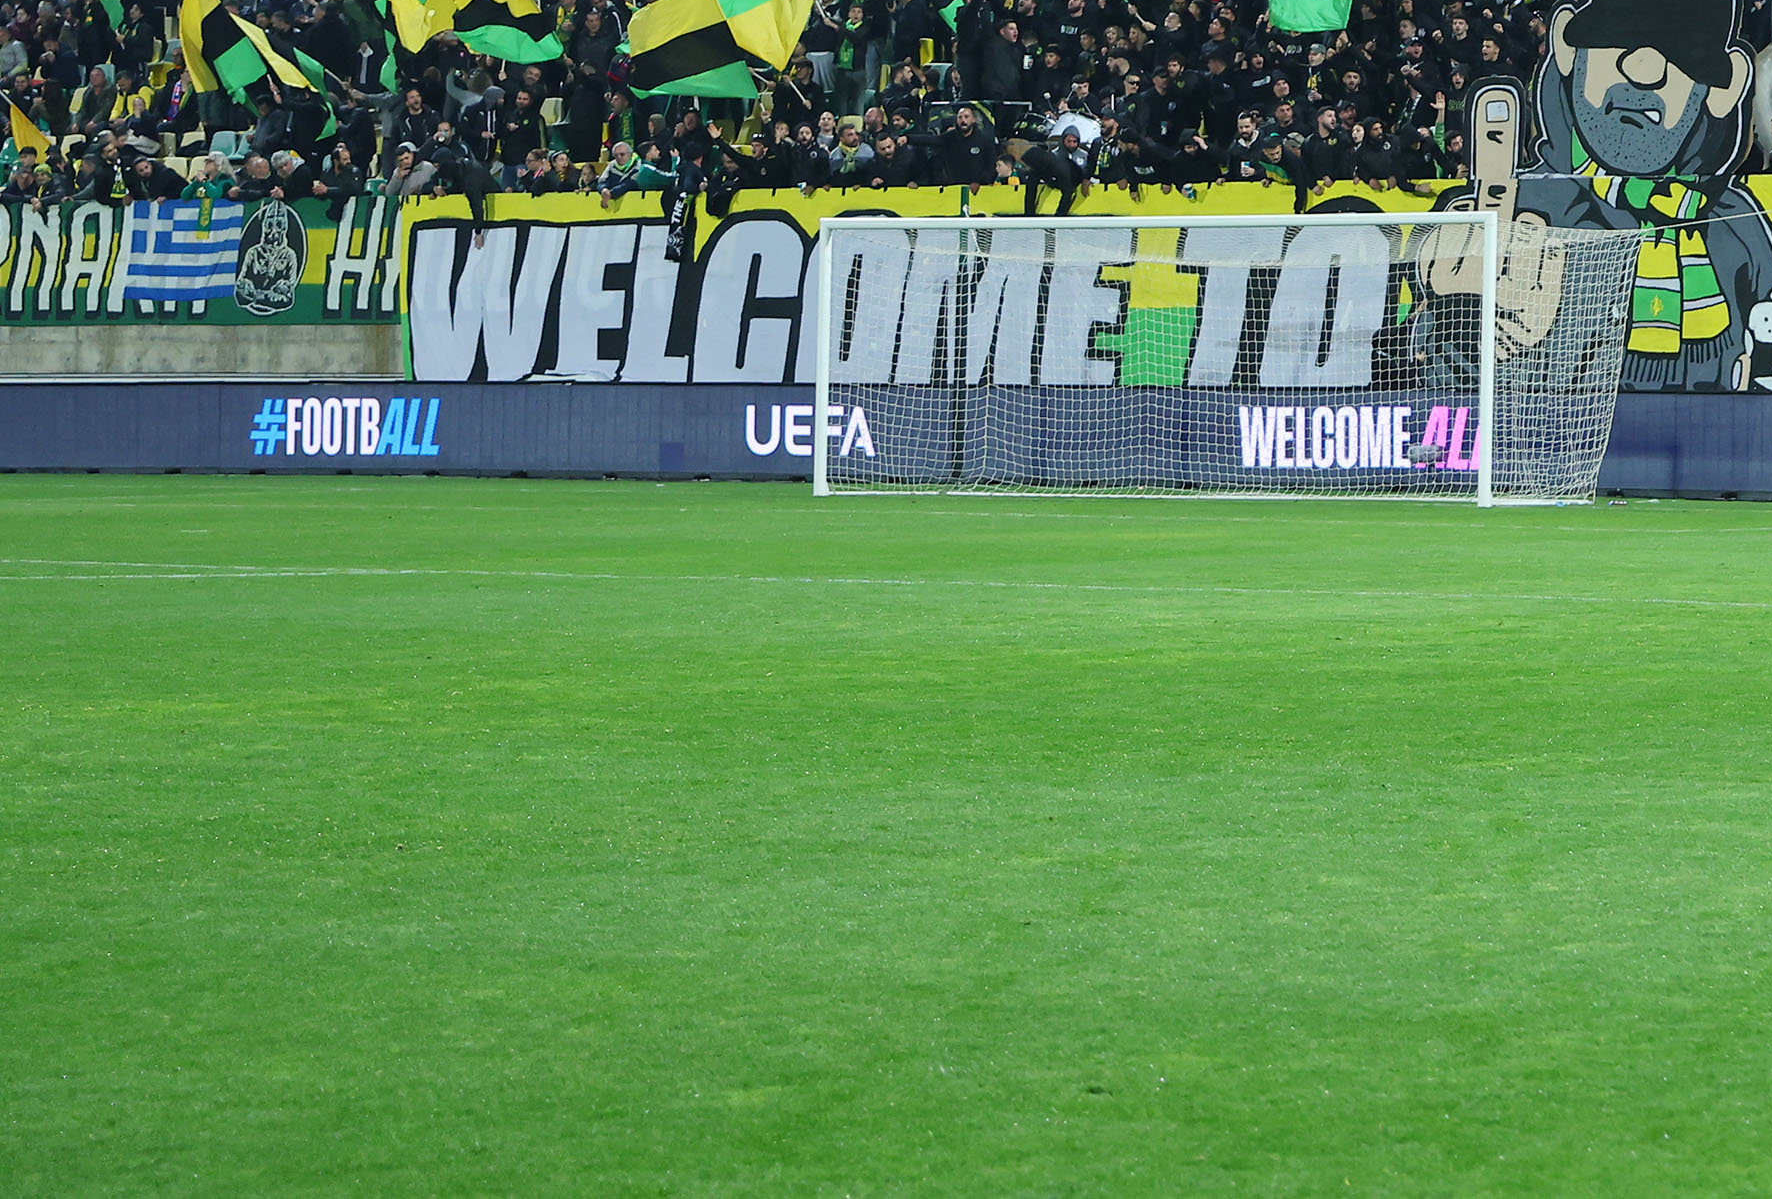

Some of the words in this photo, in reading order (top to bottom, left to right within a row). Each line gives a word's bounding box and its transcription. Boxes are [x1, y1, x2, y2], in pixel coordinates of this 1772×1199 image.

[411, 216, 1136, 387] WELCOME
[1182, 208, 1393, 388] TO
[249, 397, 441, 457] #FOOTBALL
[1238, 405, 1412, 469] WELCOME
